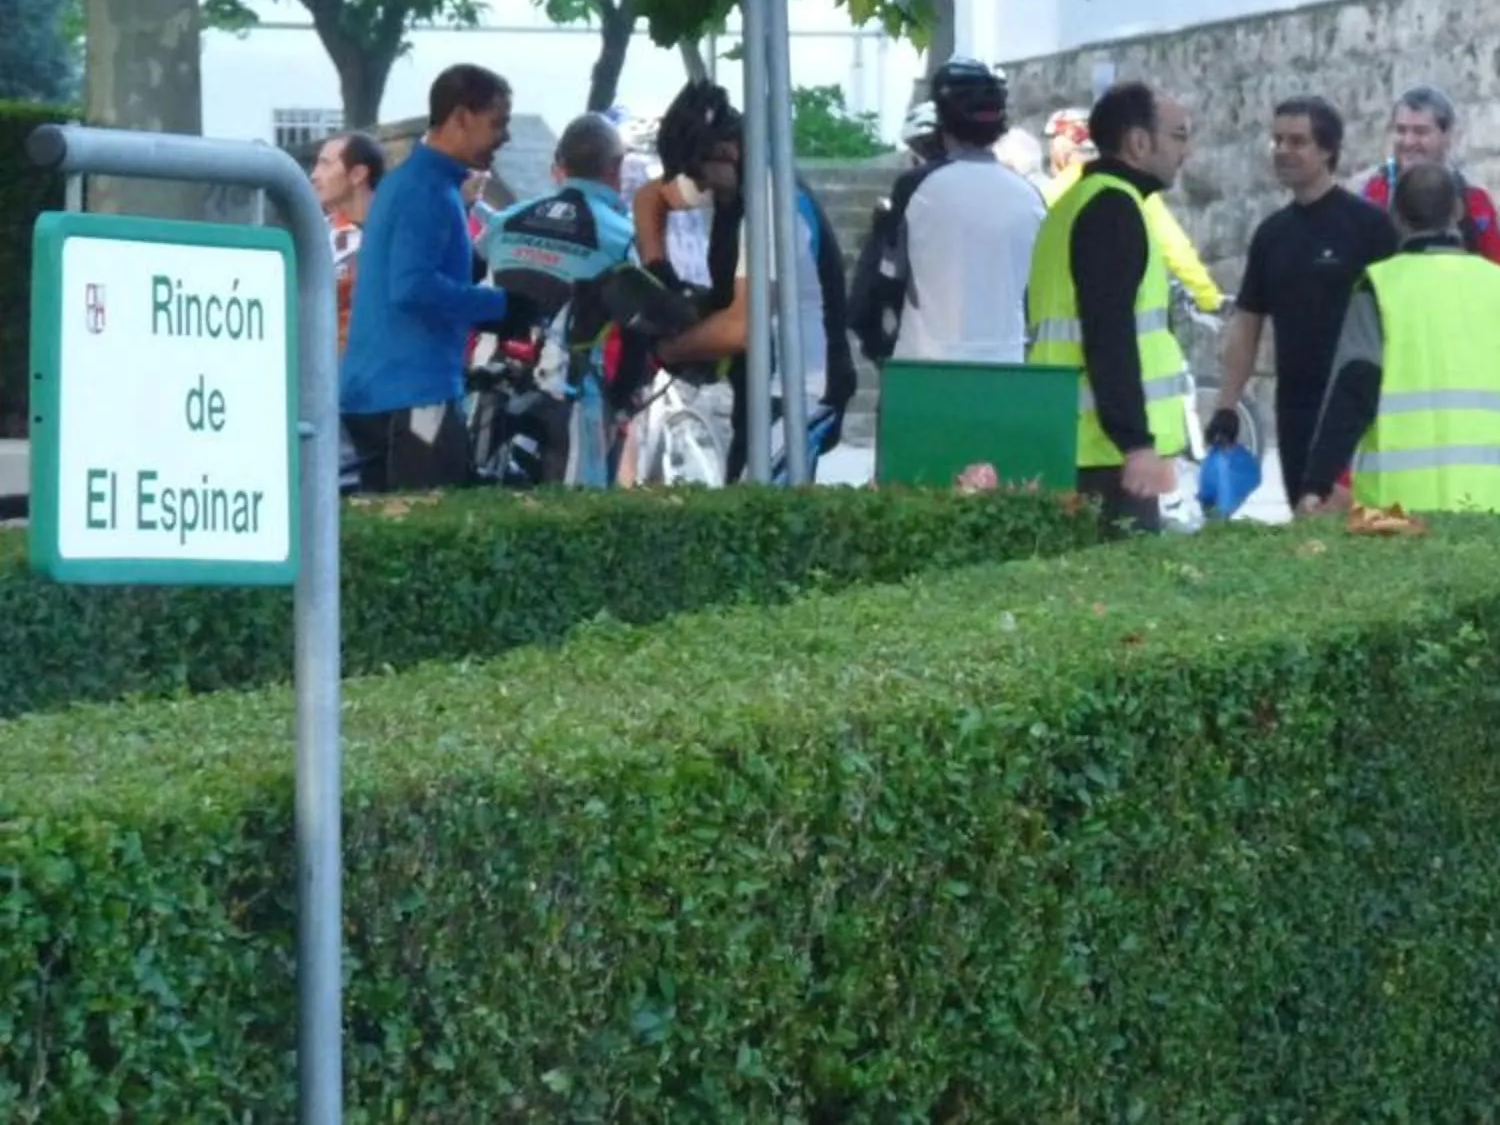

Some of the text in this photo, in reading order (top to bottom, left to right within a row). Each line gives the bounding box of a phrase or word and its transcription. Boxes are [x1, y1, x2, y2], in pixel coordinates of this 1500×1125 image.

[150, 275, 265, 341] Rincón
[185, 374, 227, 432] de
[85, 469, 264, 545] El Espinar
